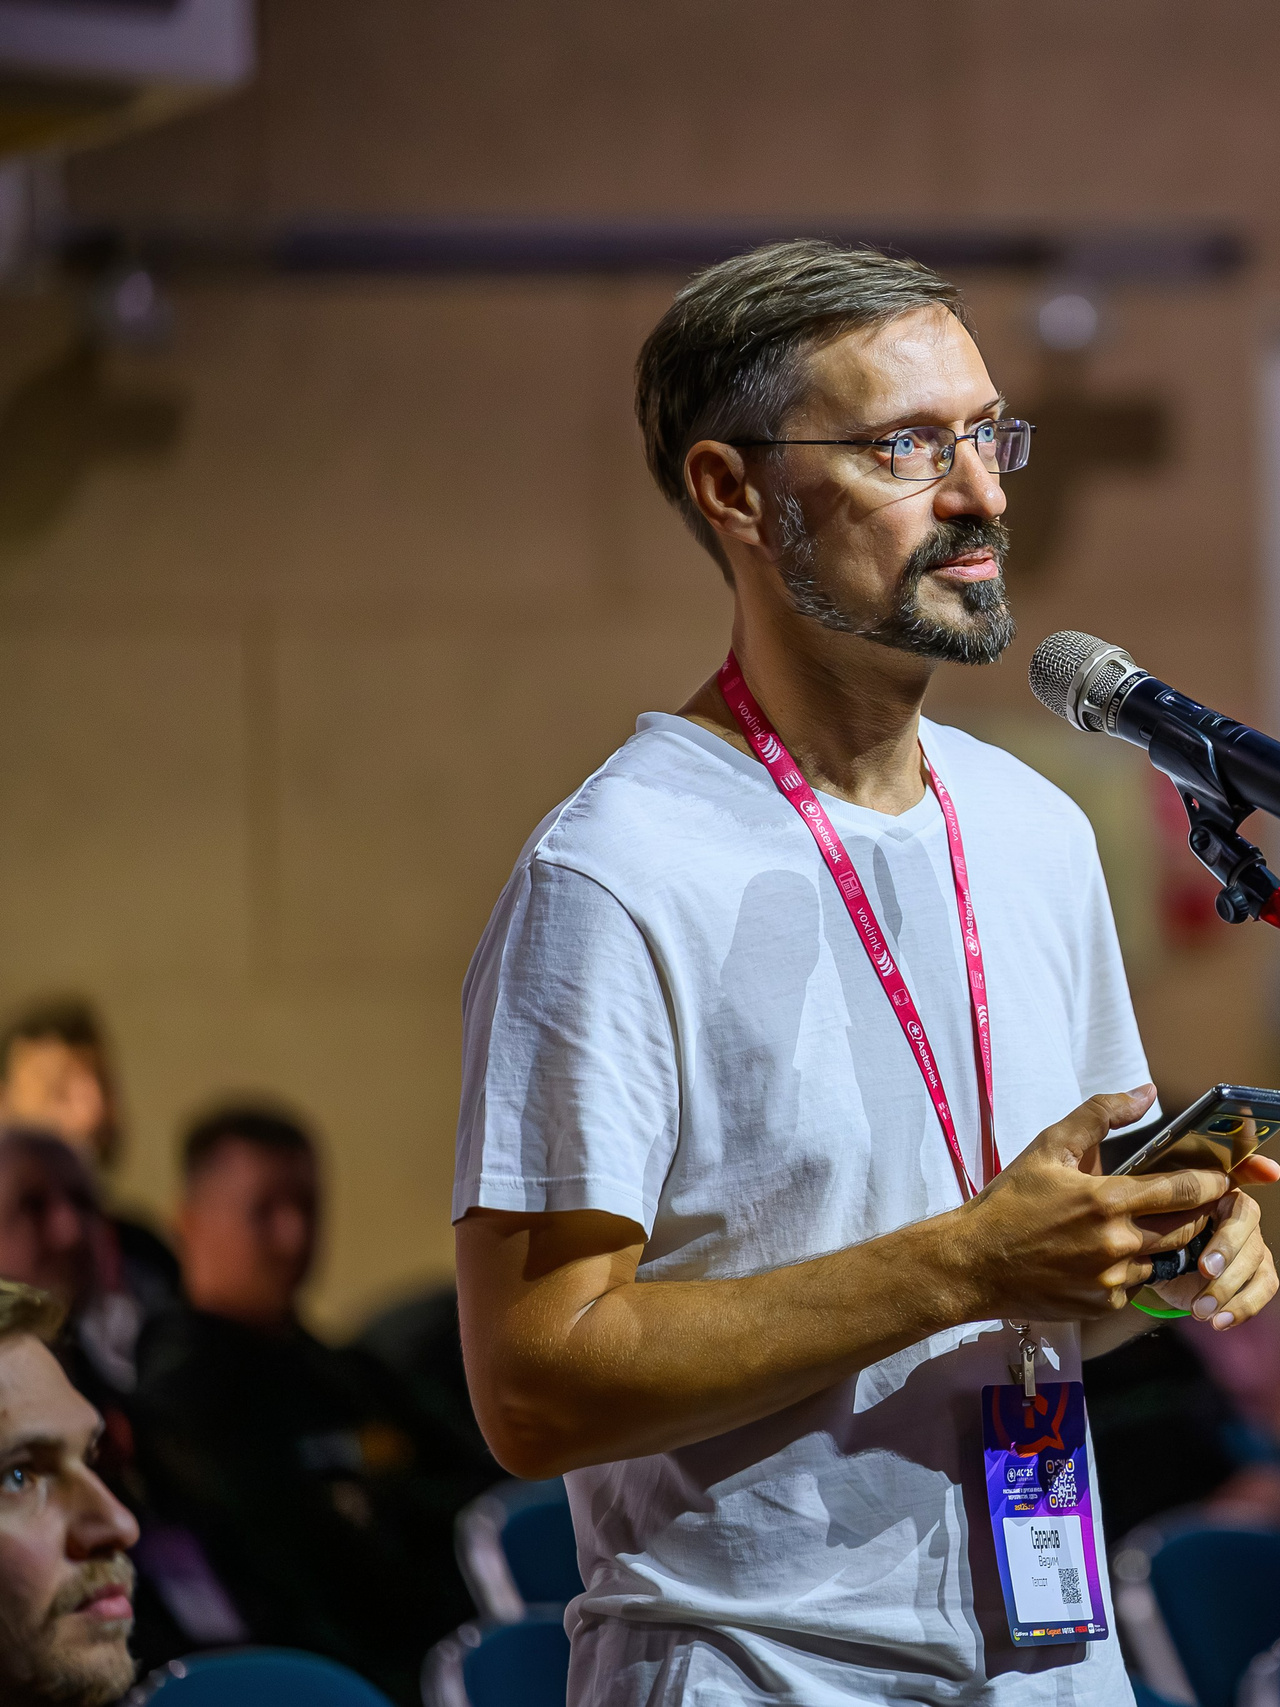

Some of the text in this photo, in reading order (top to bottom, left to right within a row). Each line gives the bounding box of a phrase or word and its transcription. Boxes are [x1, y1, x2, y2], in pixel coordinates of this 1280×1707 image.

[738, 701, 766, 741] voxlink
[1107, 697, 1121, 728] MIPRO
[812, 818, 842, 864] Asterisk
[943, 800, 959, 841] voxlink
[857, 907, 881, 952] voxlink
[963, 889, 974, 936] Asterisk
[916, 1041, 938, 1089] Asterisk
[981, 1031, 991, 1075] voxlink
[1030, 1526, 1060, 1553] Саранов
[1038, 1555, 1059, 1568] Вадим
